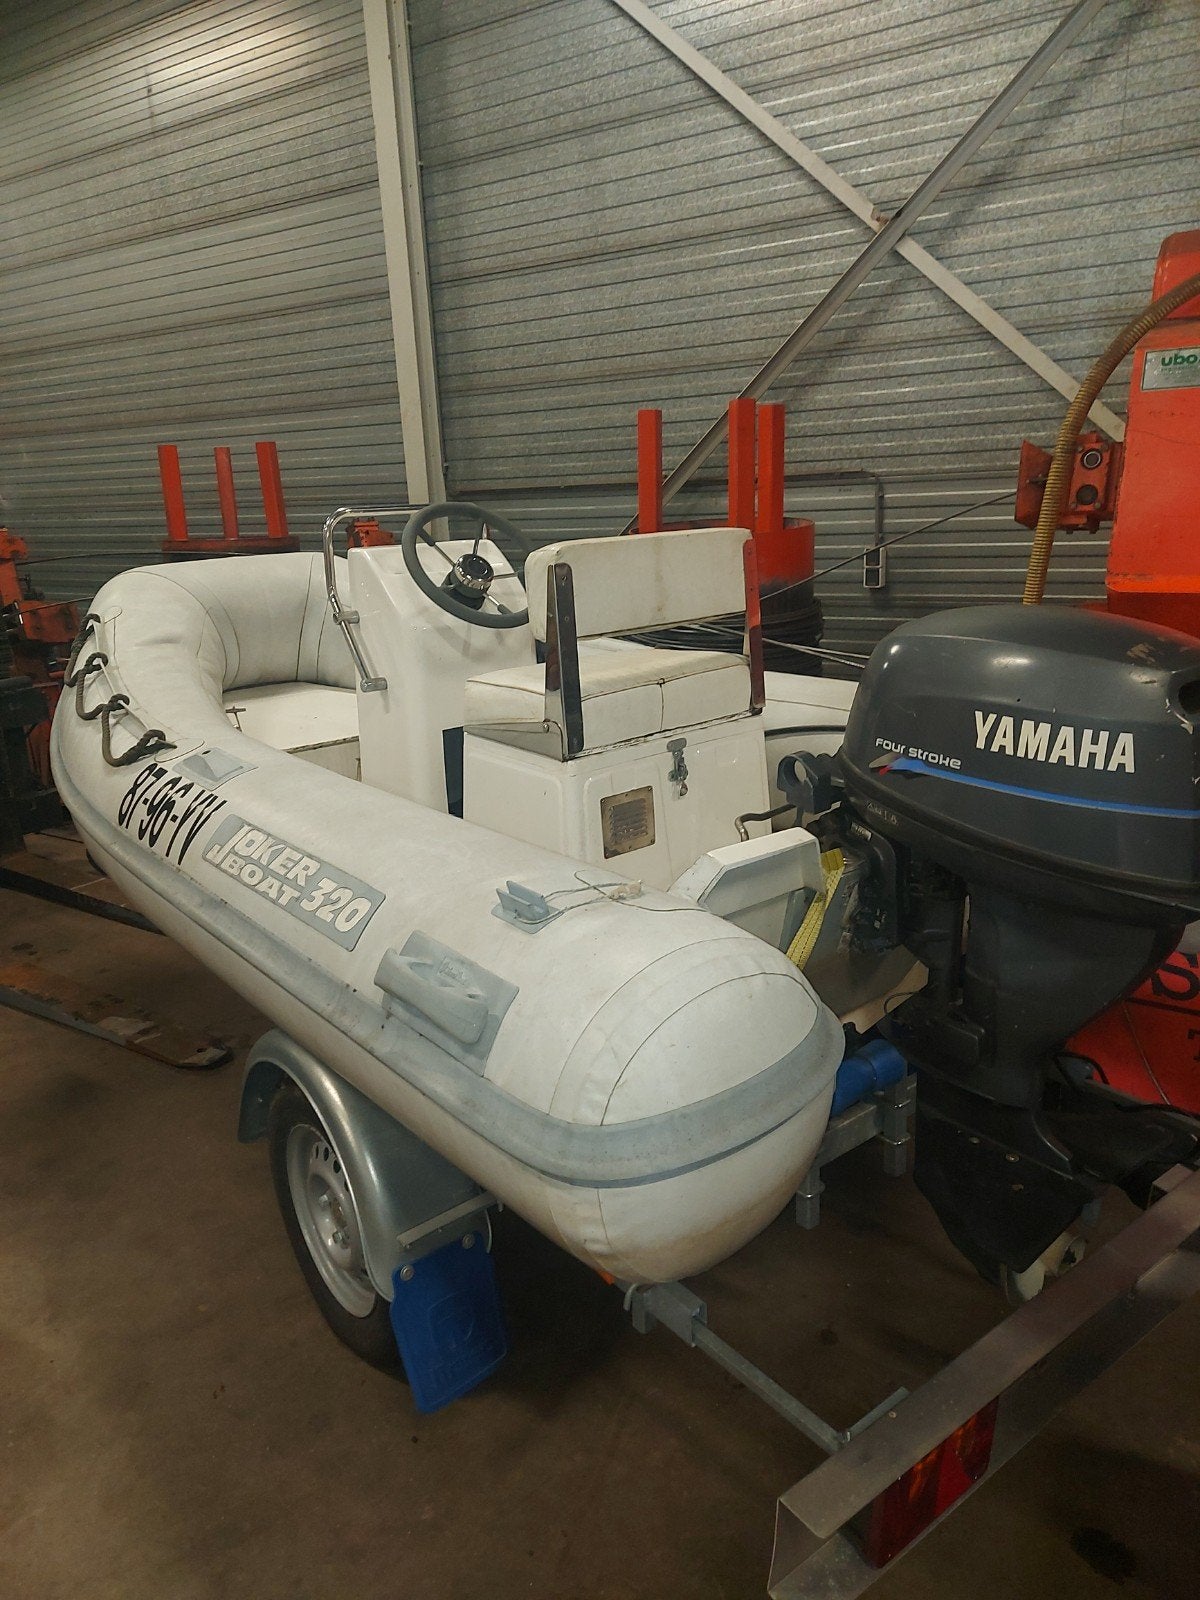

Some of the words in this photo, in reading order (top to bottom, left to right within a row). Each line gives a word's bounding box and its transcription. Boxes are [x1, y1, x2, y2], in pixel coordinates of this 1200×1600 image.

[1161, 353, 1200, 367] ubo
[974, 710, 1136, 774] YAMAHA
[118, 762, 228, 866] 87-96-YV
[206, 824, 321, 888] JOKER
[222, 856, 302, 908] BOAT
[299, 877, 373, 933] 320
